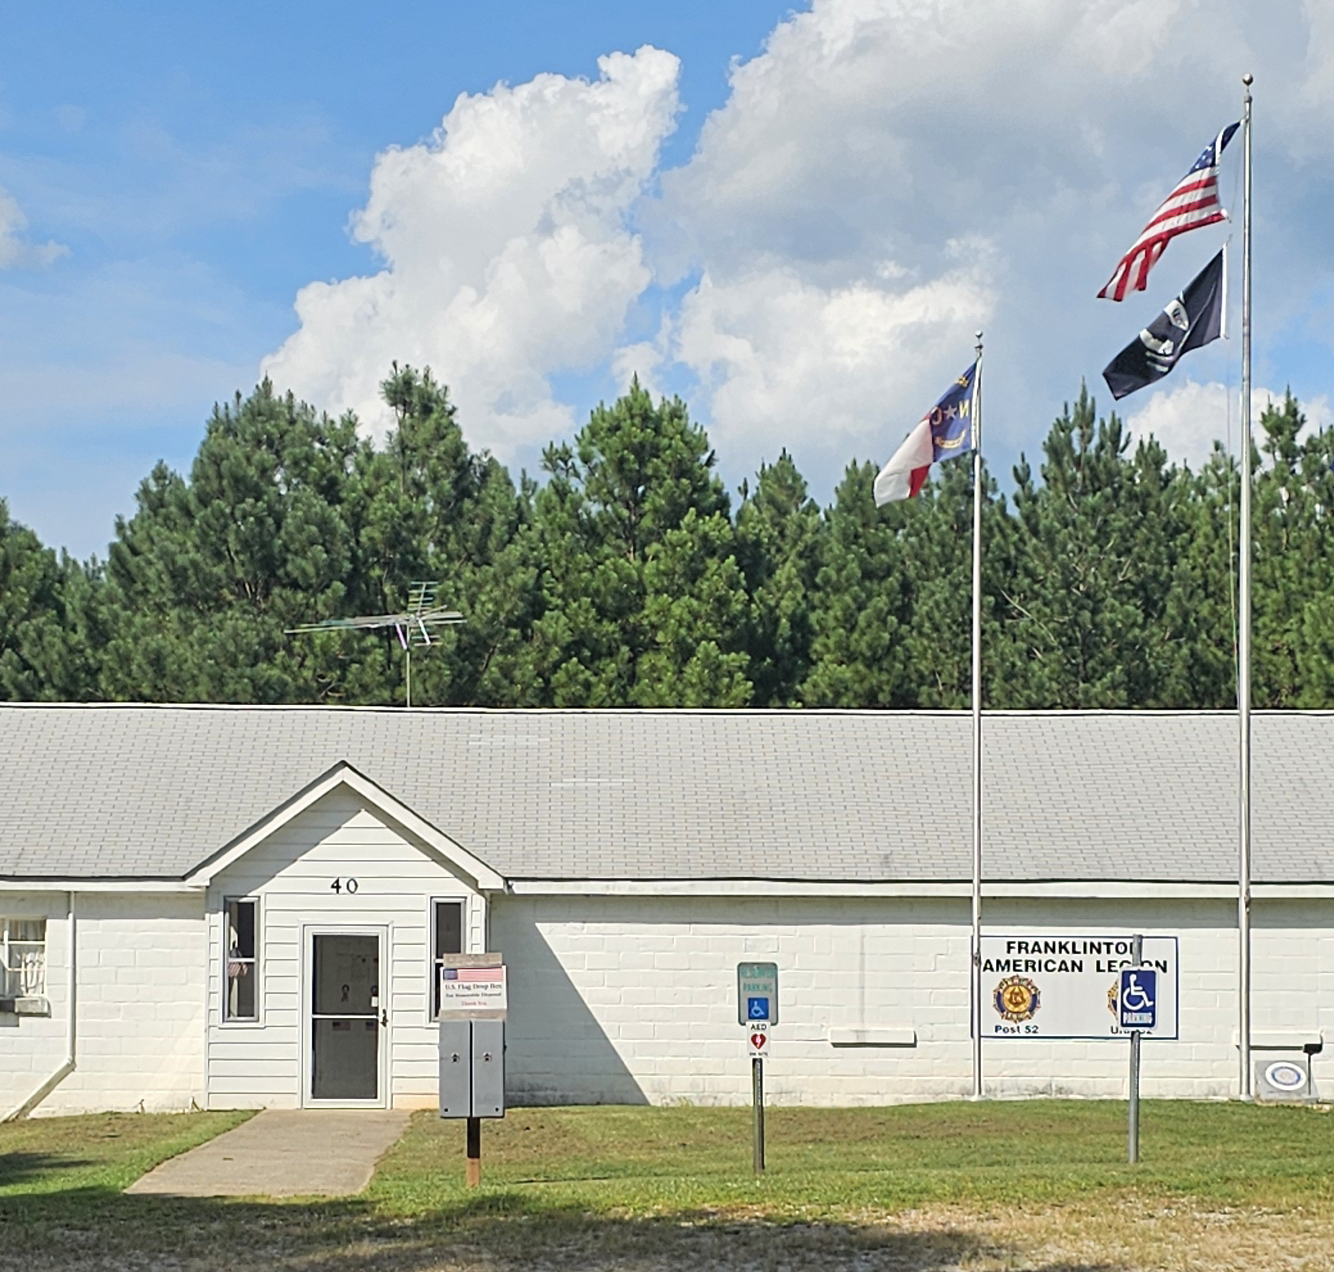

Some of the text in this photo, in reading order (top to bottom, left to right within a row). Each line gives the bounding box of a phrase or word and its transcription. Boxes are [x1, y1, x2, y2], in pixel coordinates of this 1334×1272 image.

[330, 876, 358, 894] 40
[1006, 941, 1136, 955] FRANKLINTO
[983, 959, 1168, 973] AMERICAN LEN
[750, 1023, 767, 1031] AED
[994, 1025, 1039, 1034] Post 52
